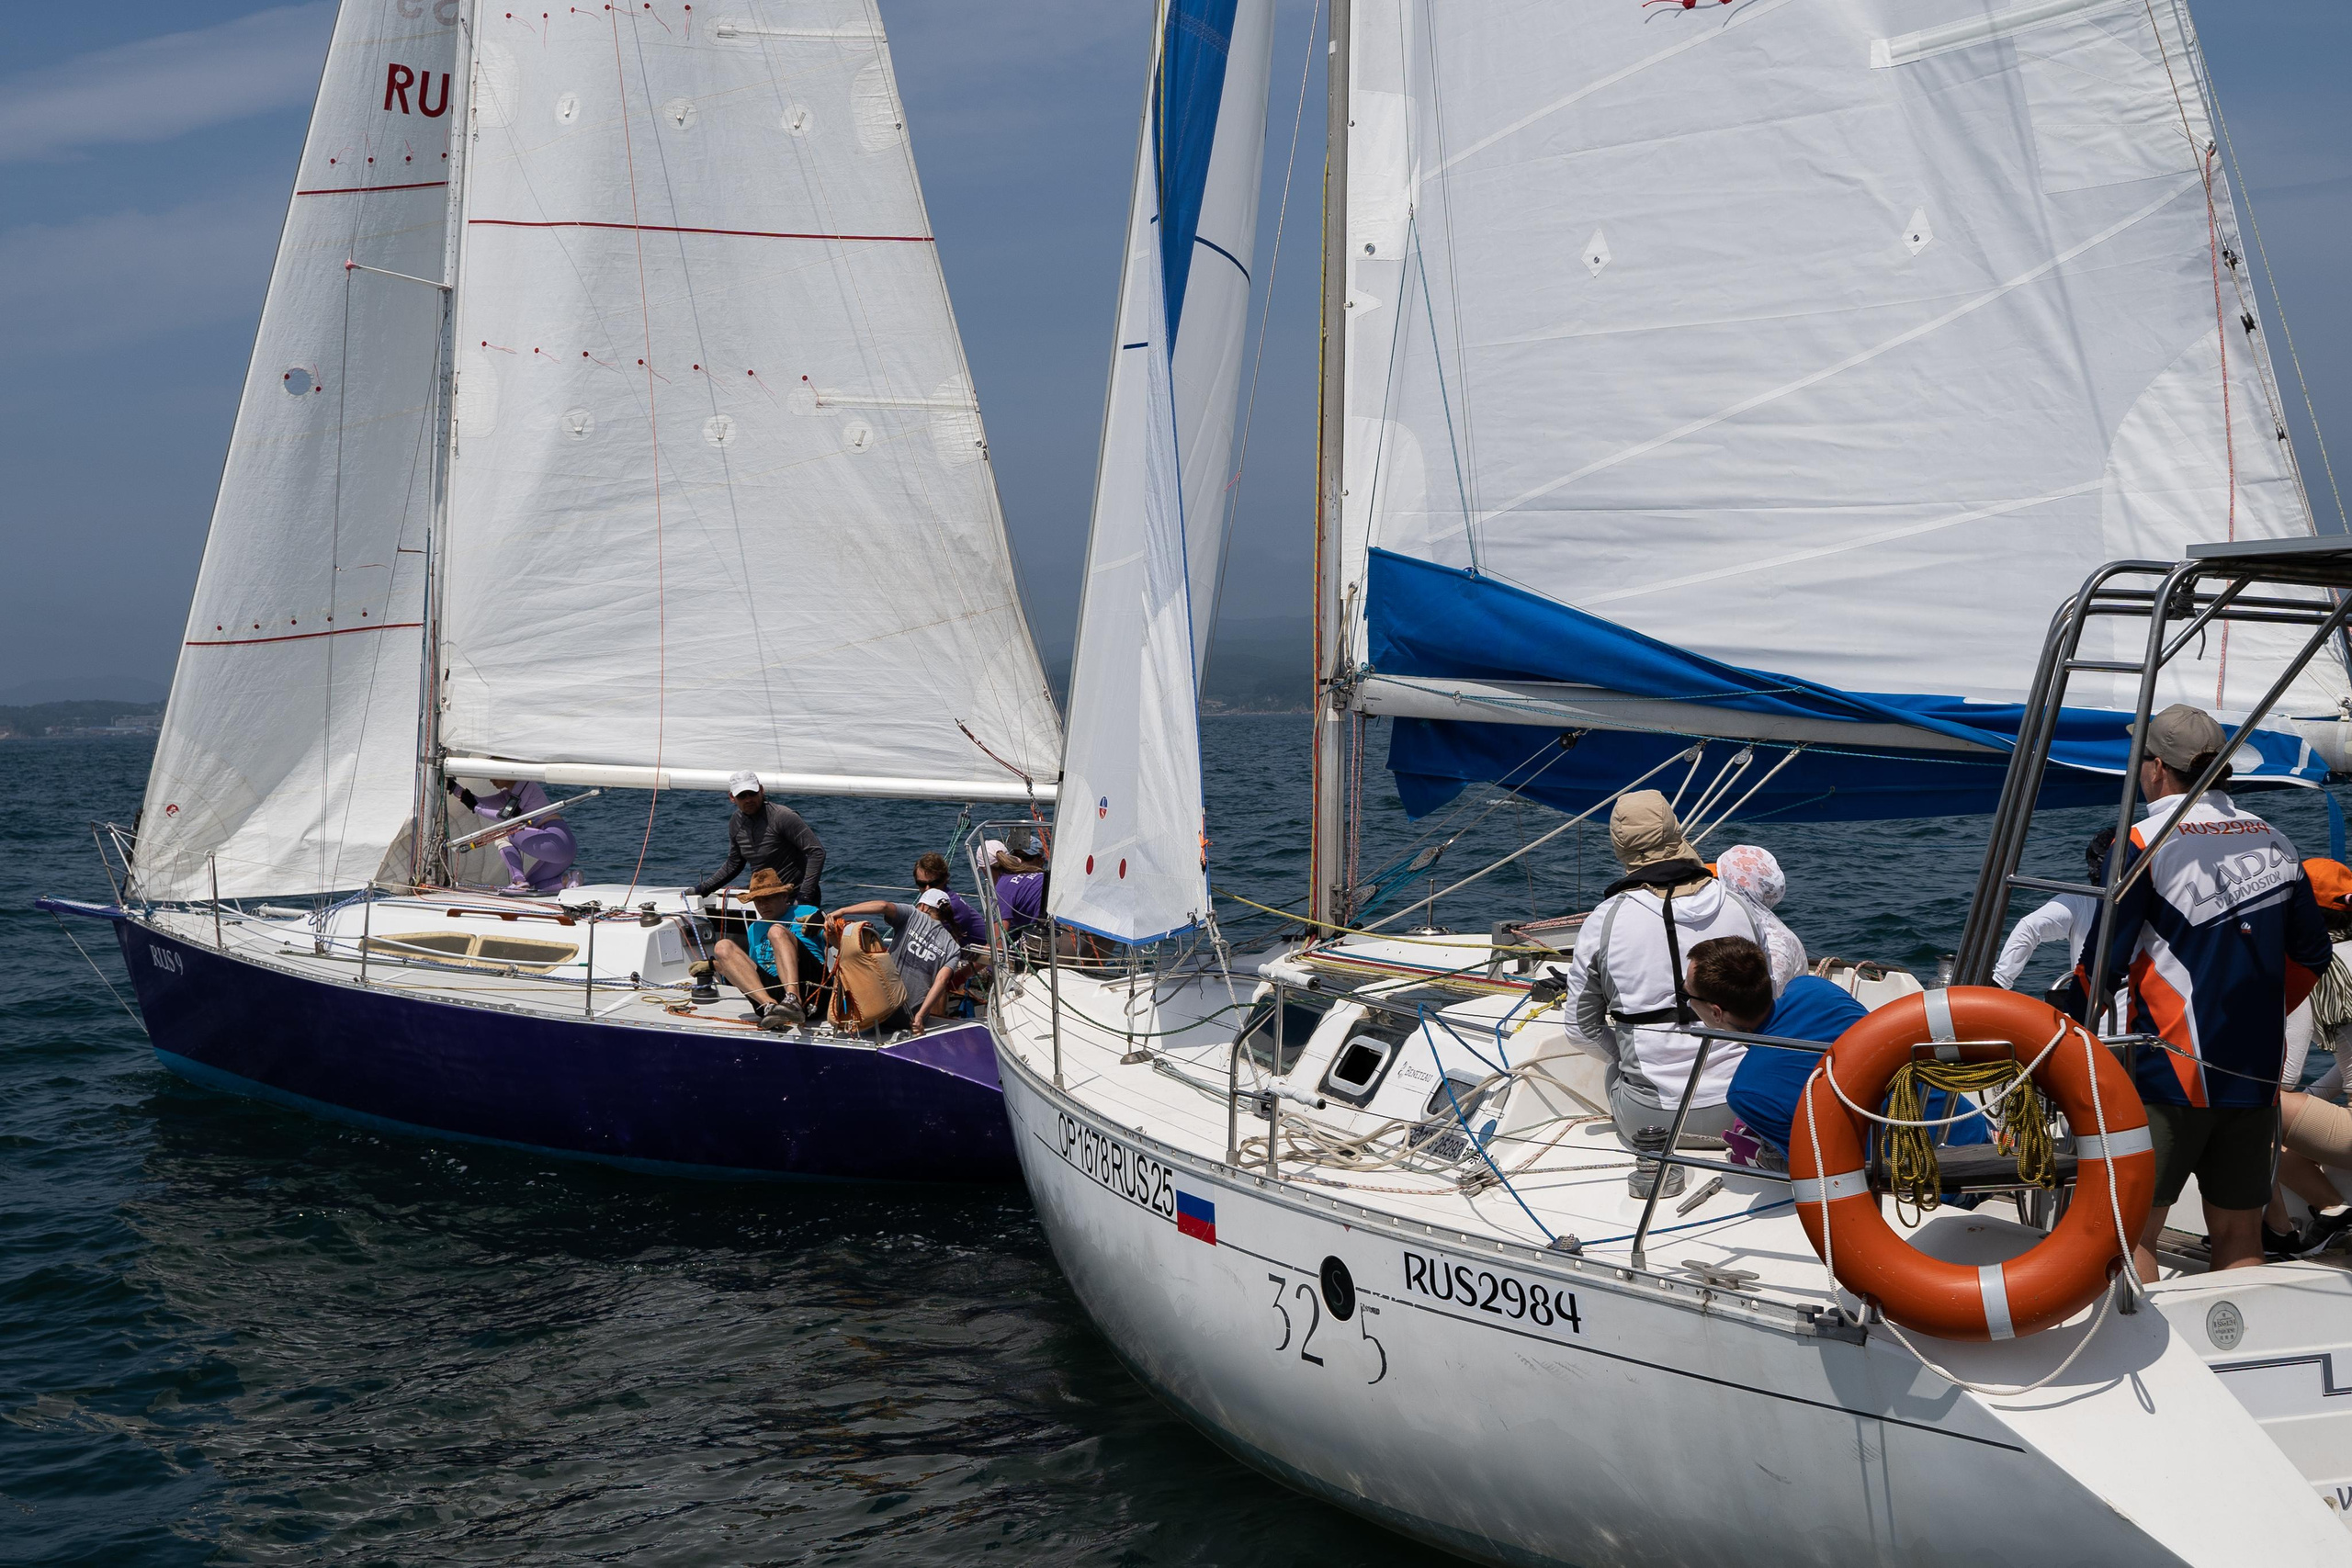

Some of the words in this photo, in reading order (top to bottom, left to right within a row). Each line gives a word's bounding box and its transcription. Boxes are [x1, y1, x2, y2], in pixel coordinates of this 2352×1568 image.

[383, 62, 453, 118] RU
[2177, 820, 2271, 836] RUS2984
[2185, 840, 2298, 907] LADA
[2214, 871, 2282, 909] VLADIVOSTOK
[907, 940, 937, 962] CUP
[1403, 1251, 1582, 1334] RUS2984
